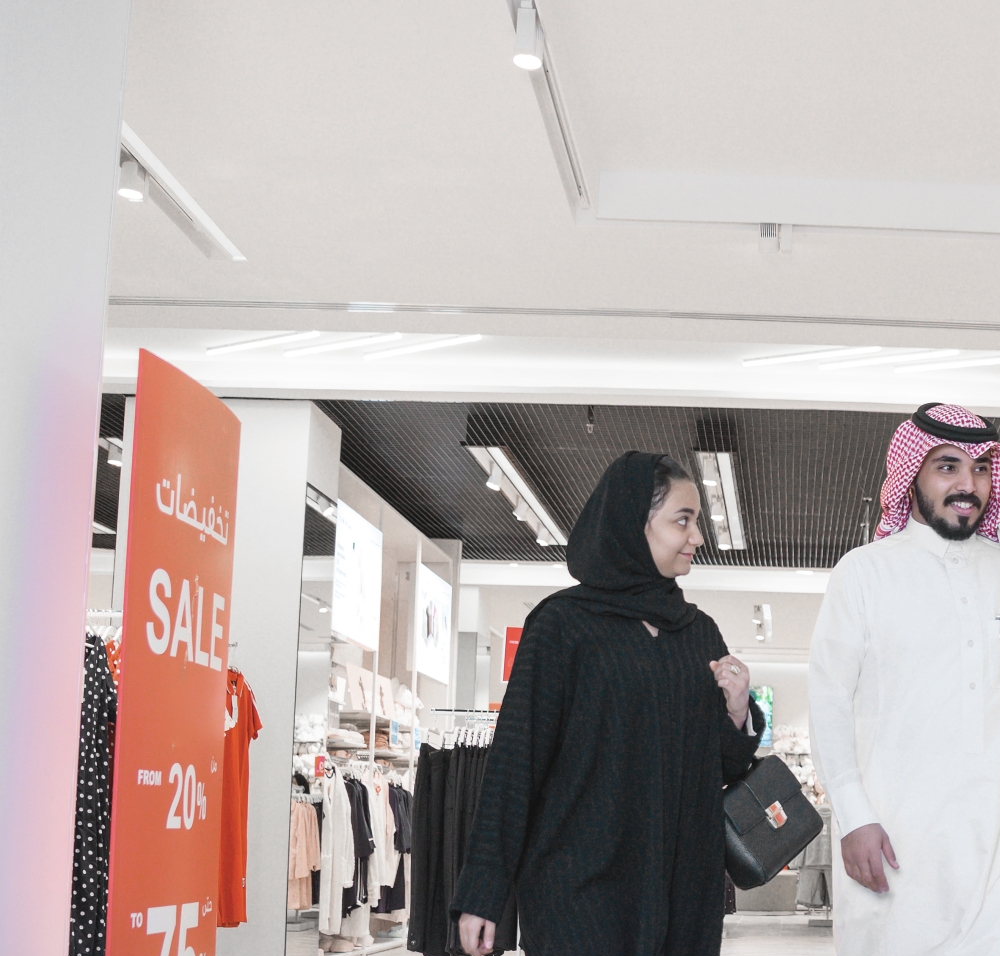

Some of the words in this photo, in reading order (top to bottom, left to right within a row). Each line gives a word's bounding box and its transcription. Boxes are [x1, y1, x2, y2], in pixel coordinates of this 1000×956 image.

[156, 473, 231, 547] تخفيضات
[146, 568, 226, 672] SALE
[137, 768, 162, 787] FROM
[165, 762, 207, 830] 20%
[130, 911, 143, 929] TO
